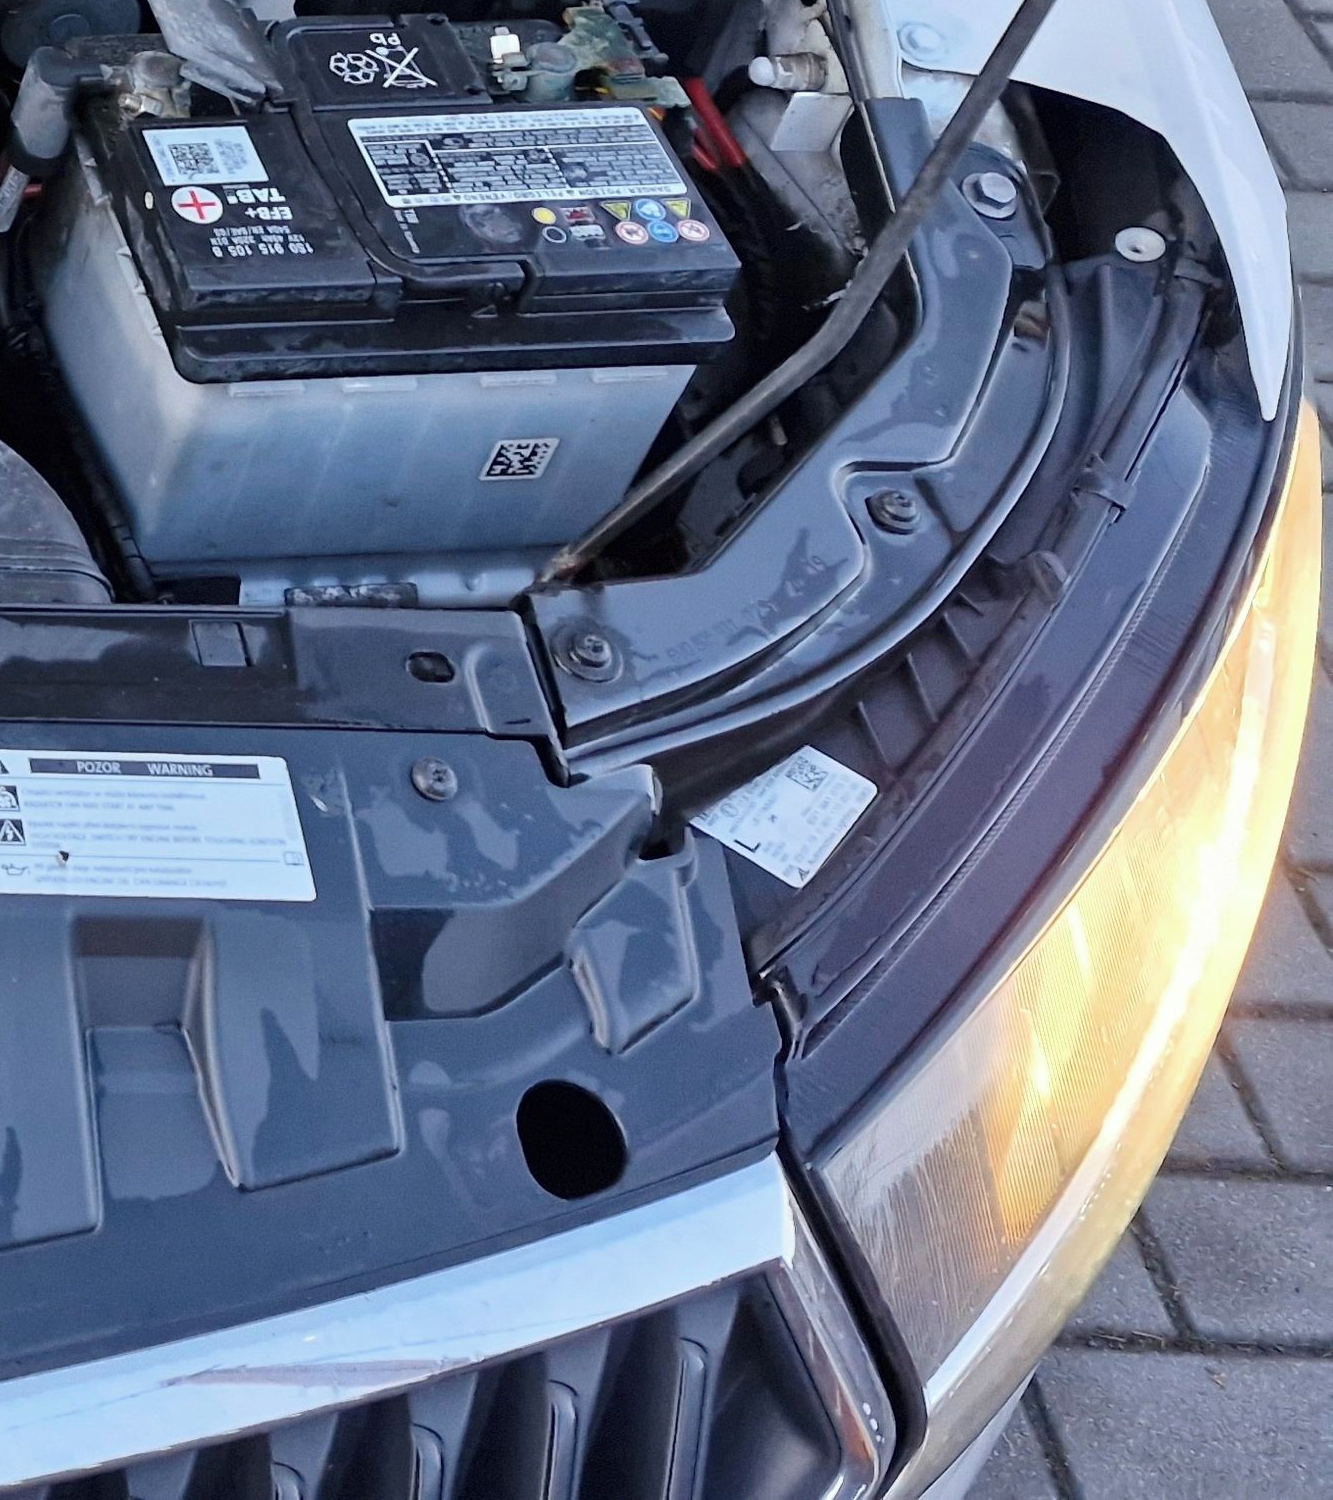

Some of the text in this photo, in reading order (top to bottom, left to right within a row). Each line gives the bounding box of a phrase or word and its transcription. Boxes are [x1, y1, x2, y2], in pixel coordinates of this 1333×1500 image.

[370, 33, 401, 45] Pb
[235, 187, 286, 203] TAB
[244, 206, 293, 220] EFB+
[258, 243, 285, 255] 915
[76, 760, 214, 777] POZOR WARNING
[734, 839, 761, 853] L
